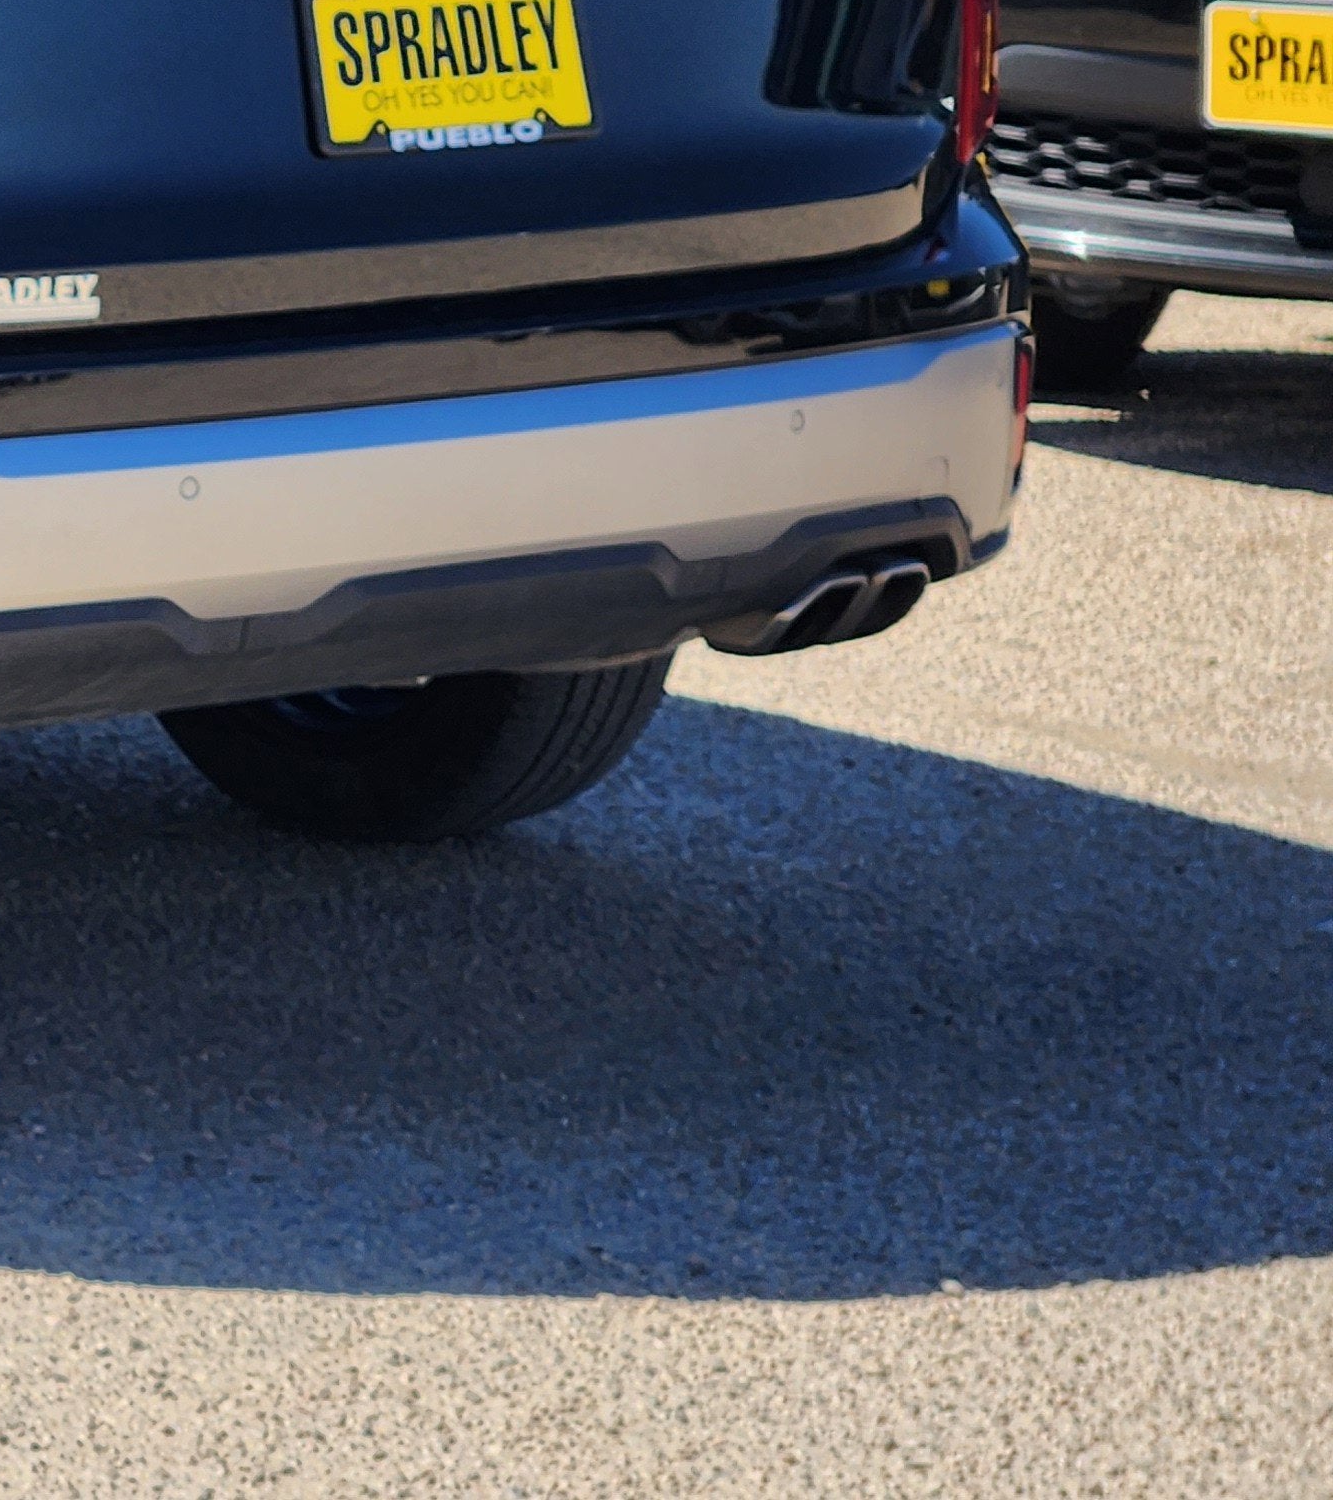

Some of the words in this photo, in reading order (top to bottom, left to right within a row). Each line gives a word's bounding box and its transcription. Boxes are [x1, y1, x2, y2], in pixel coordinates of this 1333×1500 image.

[333, 0, 558, 87] SPRADLEY
[1228, 32, 1333, 85] SPRA
[362, 89, 401, 111] OH
[406, 84, 442, 107] YES
[449, 80, 495, 105] YOU
[389, 118, 543, 152] PUEBLO
